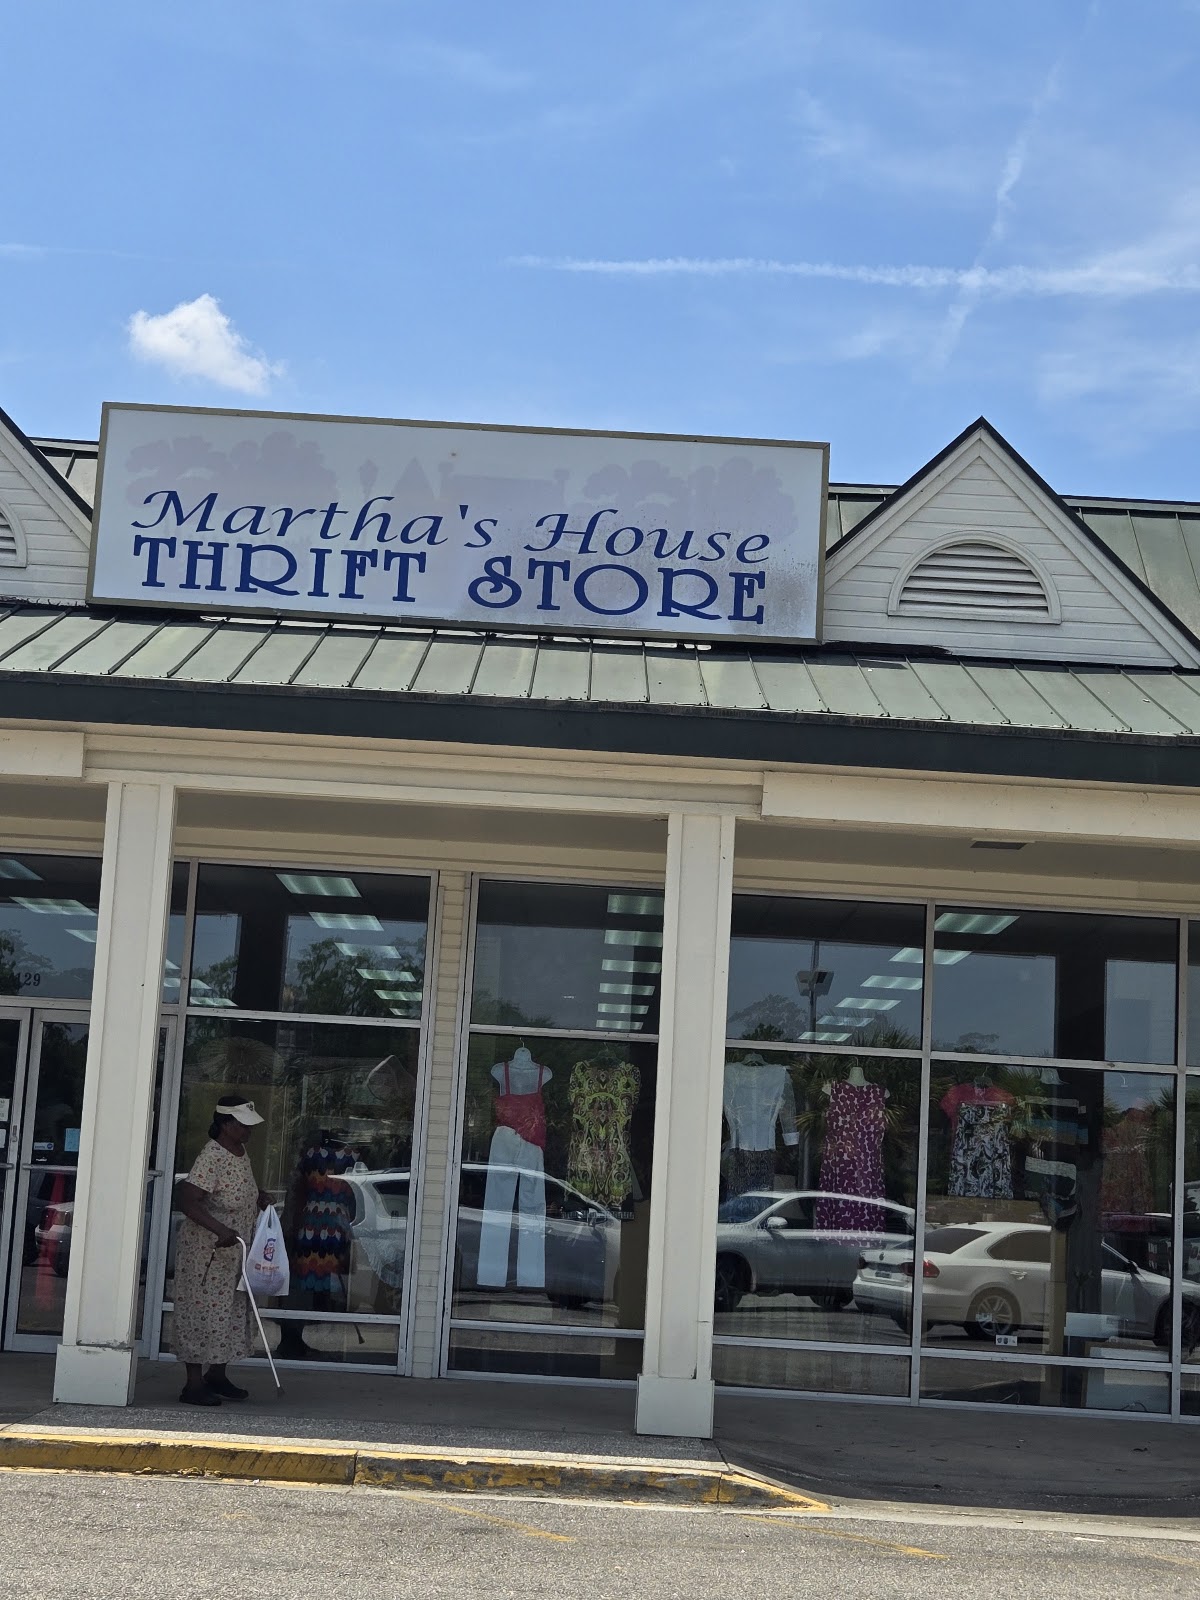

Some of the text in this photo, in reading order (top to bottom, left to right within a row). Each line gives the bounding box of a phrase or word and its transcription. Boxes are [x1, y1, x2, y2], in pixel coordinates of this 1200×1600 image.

[132, 491, 770, 564] Martha's House
[133, 535, 766, 625] THRIFT STORE
